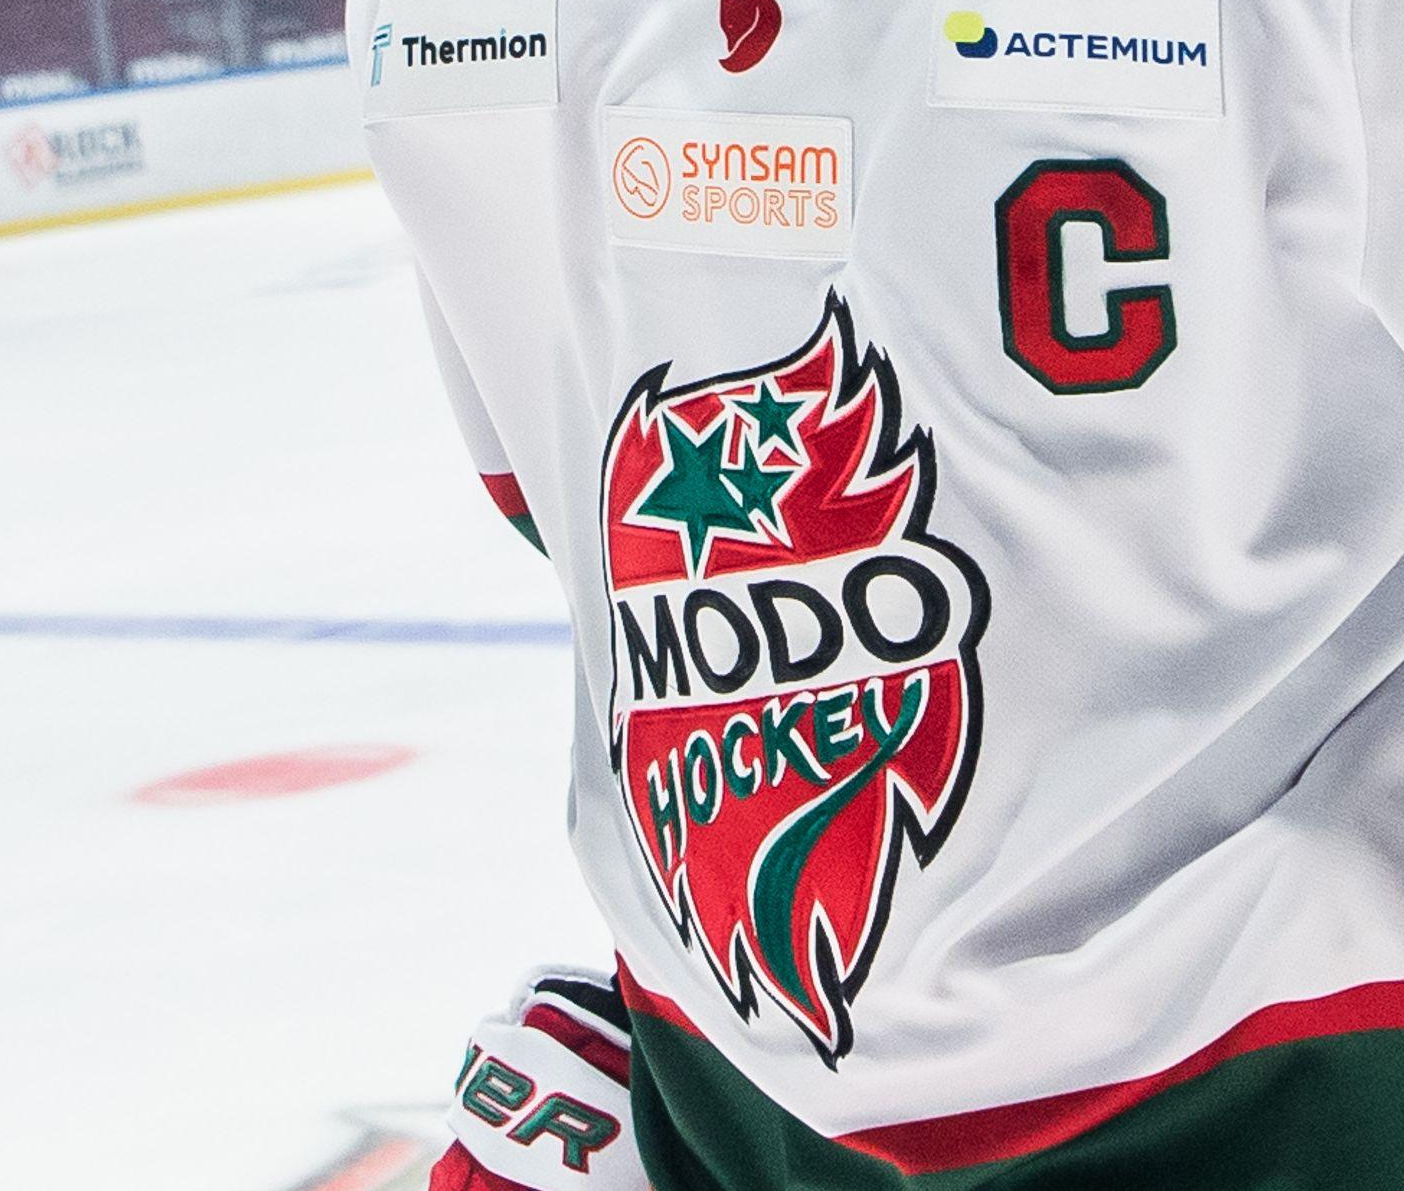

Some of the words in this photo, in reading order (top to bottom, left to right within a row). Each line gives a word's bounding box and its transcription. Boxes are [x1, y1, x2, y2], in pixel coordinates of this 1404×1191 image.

[401, 27, 548, 68] Thermion
[1003, 30, 1208, 68] ACTEMIUM
[681, 141, 838, 186] SYNSAM
[681, 185, 839, 229] SPORTS
[995, 158, 1177, 396] C
[616, 554, 951, 702] MODO
[646, 667, 932, 872] HOCKEY
